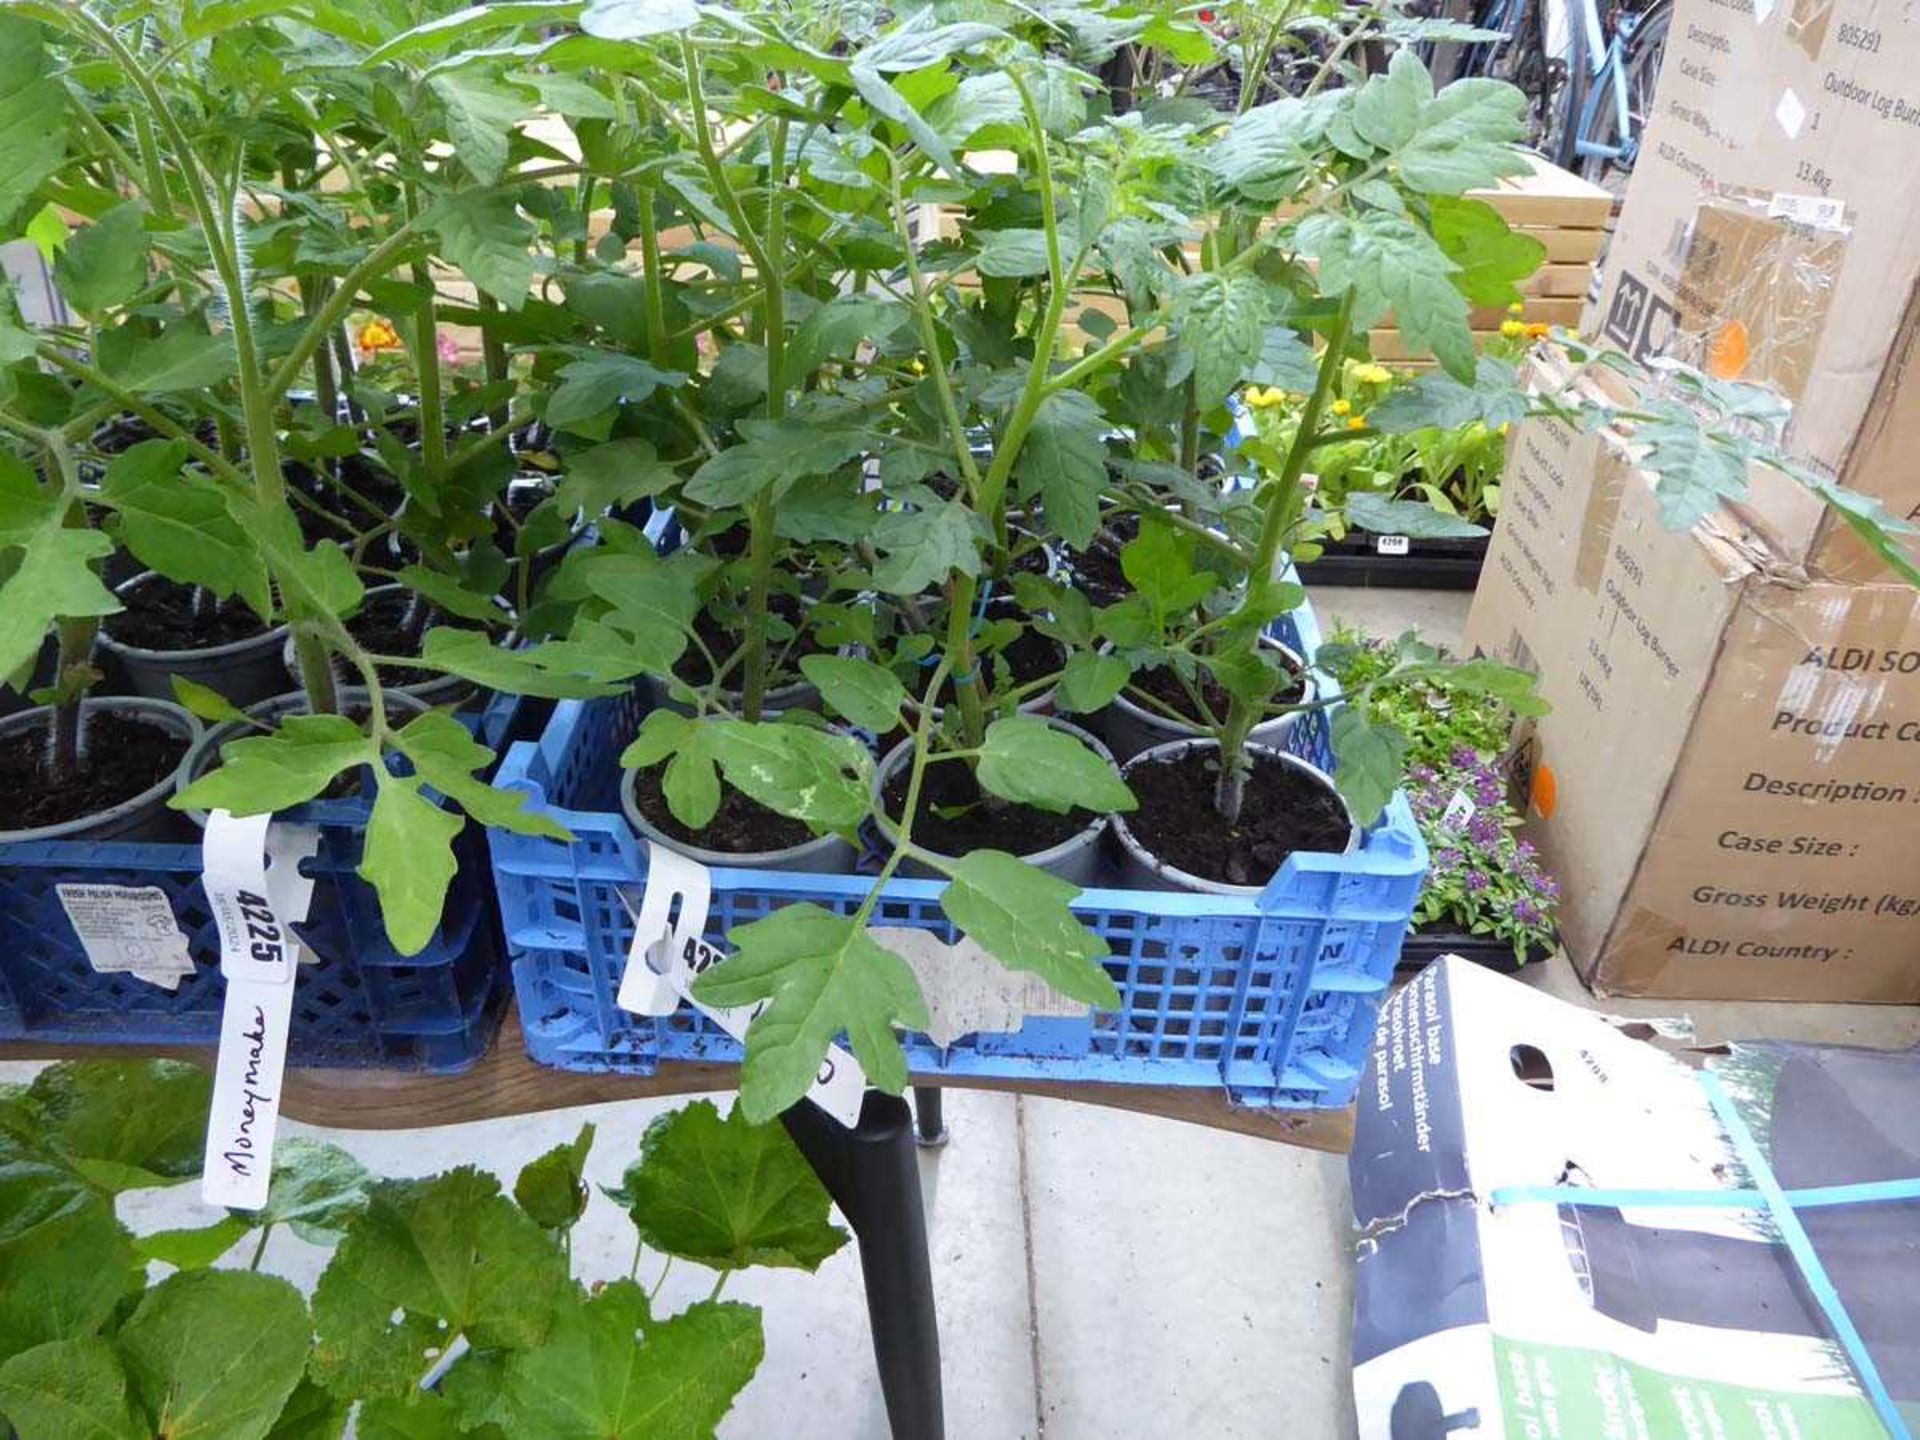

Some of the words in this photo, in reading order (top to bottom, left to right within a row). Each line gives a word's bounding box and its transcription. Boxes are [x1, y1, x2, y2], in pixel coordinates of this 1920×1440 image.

[1823, 71, 1872, 105] Outdoor
[1871, 90, 1893, 119] Log
[1650, 635, 1681, 679] Burner
[1801, 645, 1875, 673] ALDI
[1771, 711, 1891, 741] Product
[1743, 772, 1907, 804] Description
[1717, 830, 1783, 855] Case
[1788, 836, 1844, 858] Size
[1692, 886, 1768, 909] Gross
[1777, 891, 1870, 915] Weight
[236, 889, 283, 962] 4225
[682, 936, 724, 974] 42
[1666, 935, 1731, 957] ALDI
[1736, 941, 1837, 963] Country
[1375, 1026, 1391, 1046] de
[1426, 1024, 1443, 1065] base
[1373, 1048, 1394, 1111] parasol
